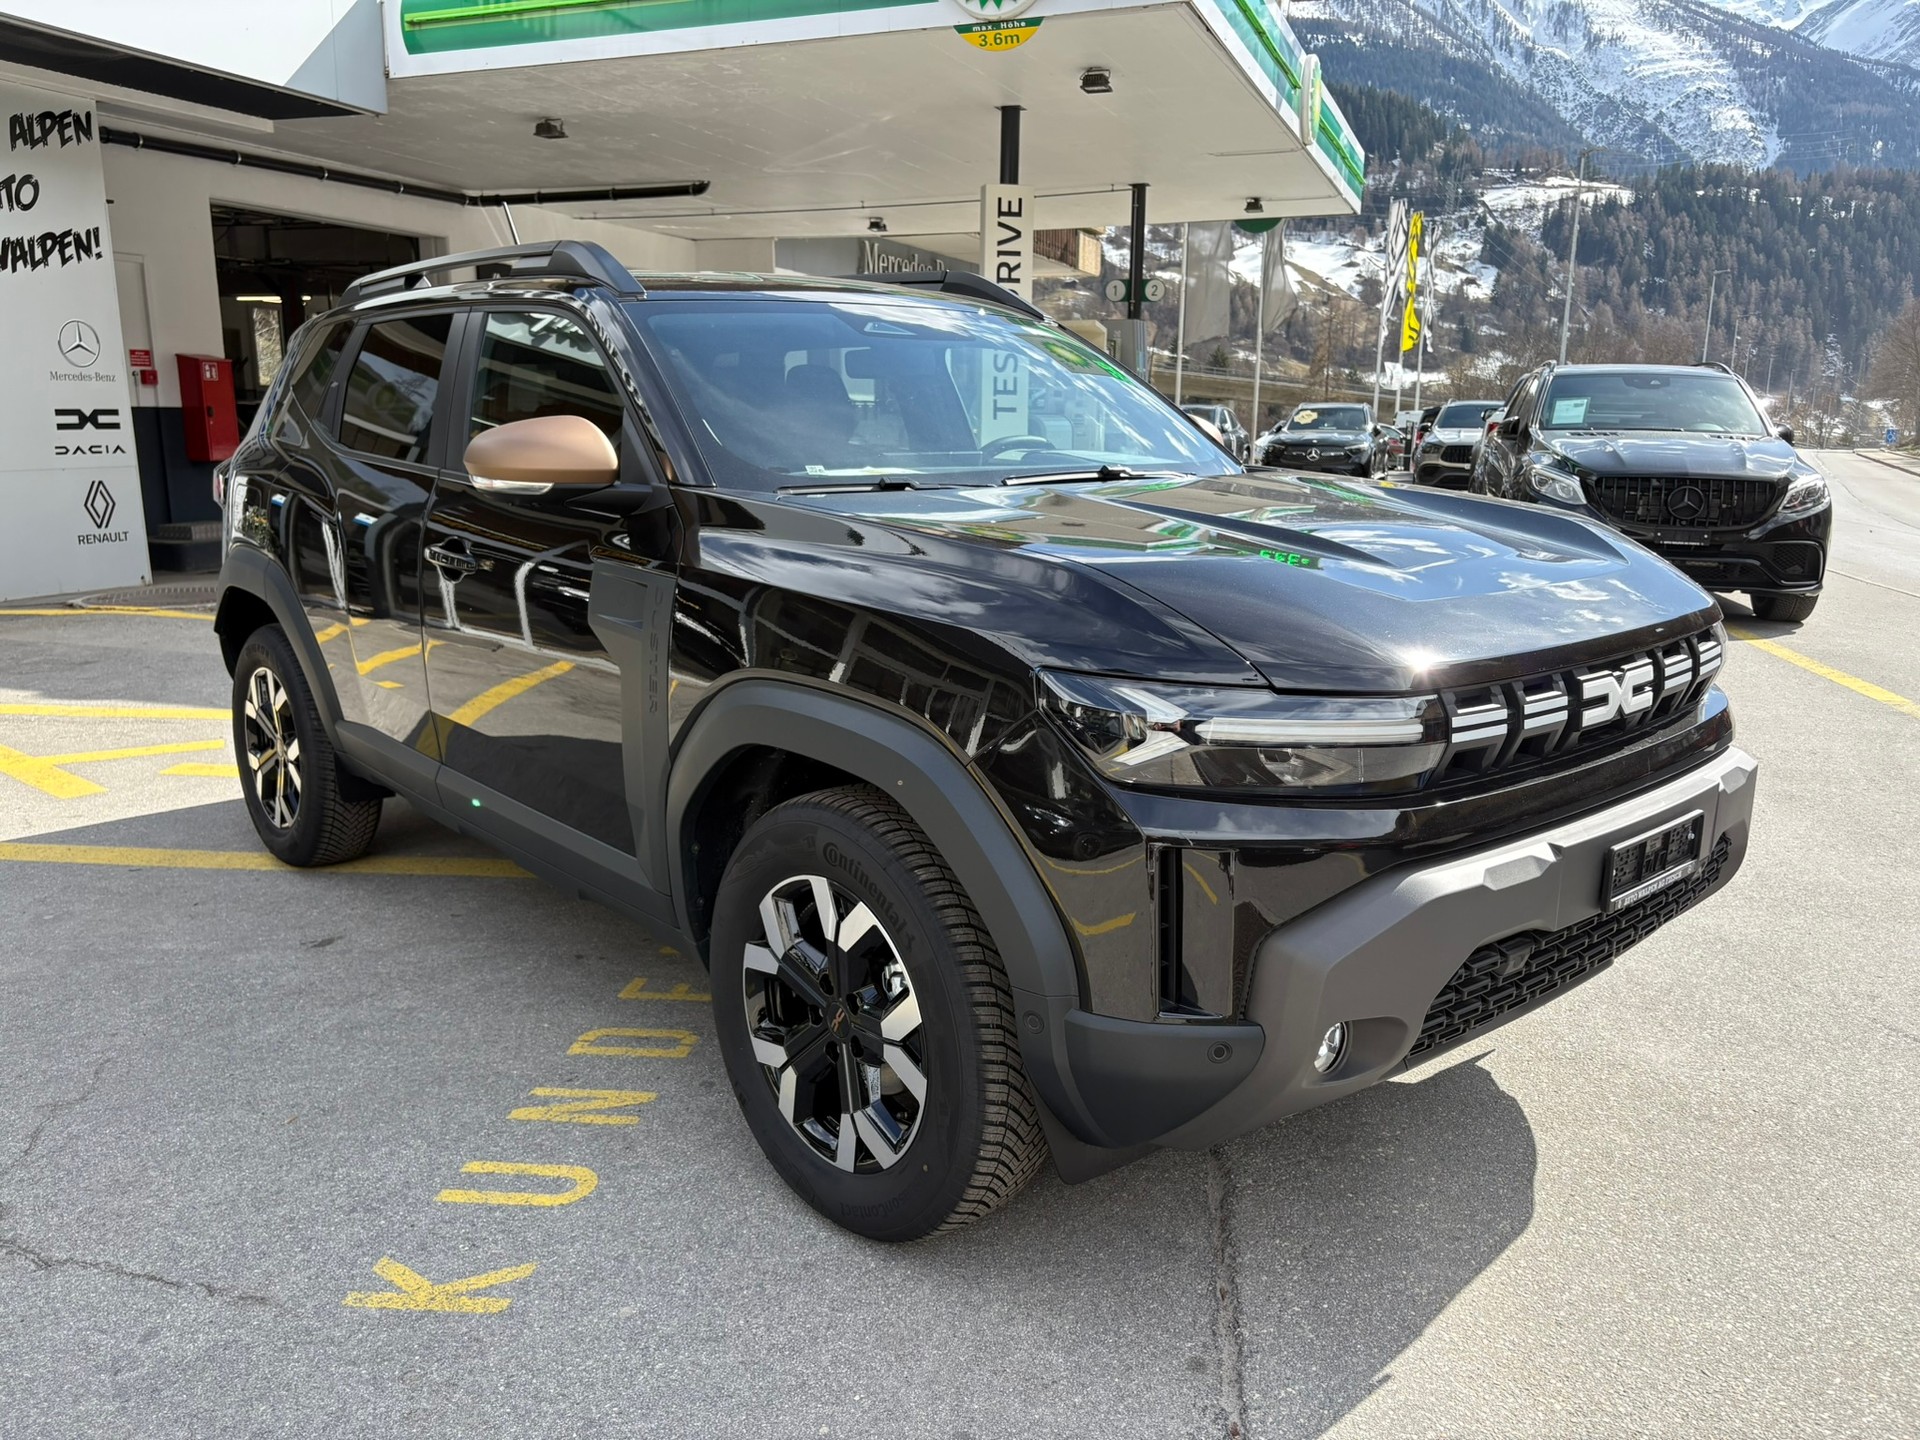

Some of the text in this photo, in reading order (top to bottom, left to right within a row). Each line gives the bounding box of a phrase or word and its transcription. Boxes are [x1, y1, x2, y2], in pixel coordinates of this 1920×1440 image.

[972, 20, 1027, 32] max. Höhe
[978, 32, 1020, 47] 3.6m
[9, 109, 93, 151] ALPEN
[0, 174, 40, 212] TO
[997, 197, 1022, 298] RIVE
[49, 370, 116, 383] Mercedes-Benz
[993, 353, 1019, 420] TES
[54, 444, 126, 456] DACIA
[77, 531, 129, 546] RENAULT
[822, 841, 908, 934] Continental
[342, 945, 713, 1314] KUNDE
